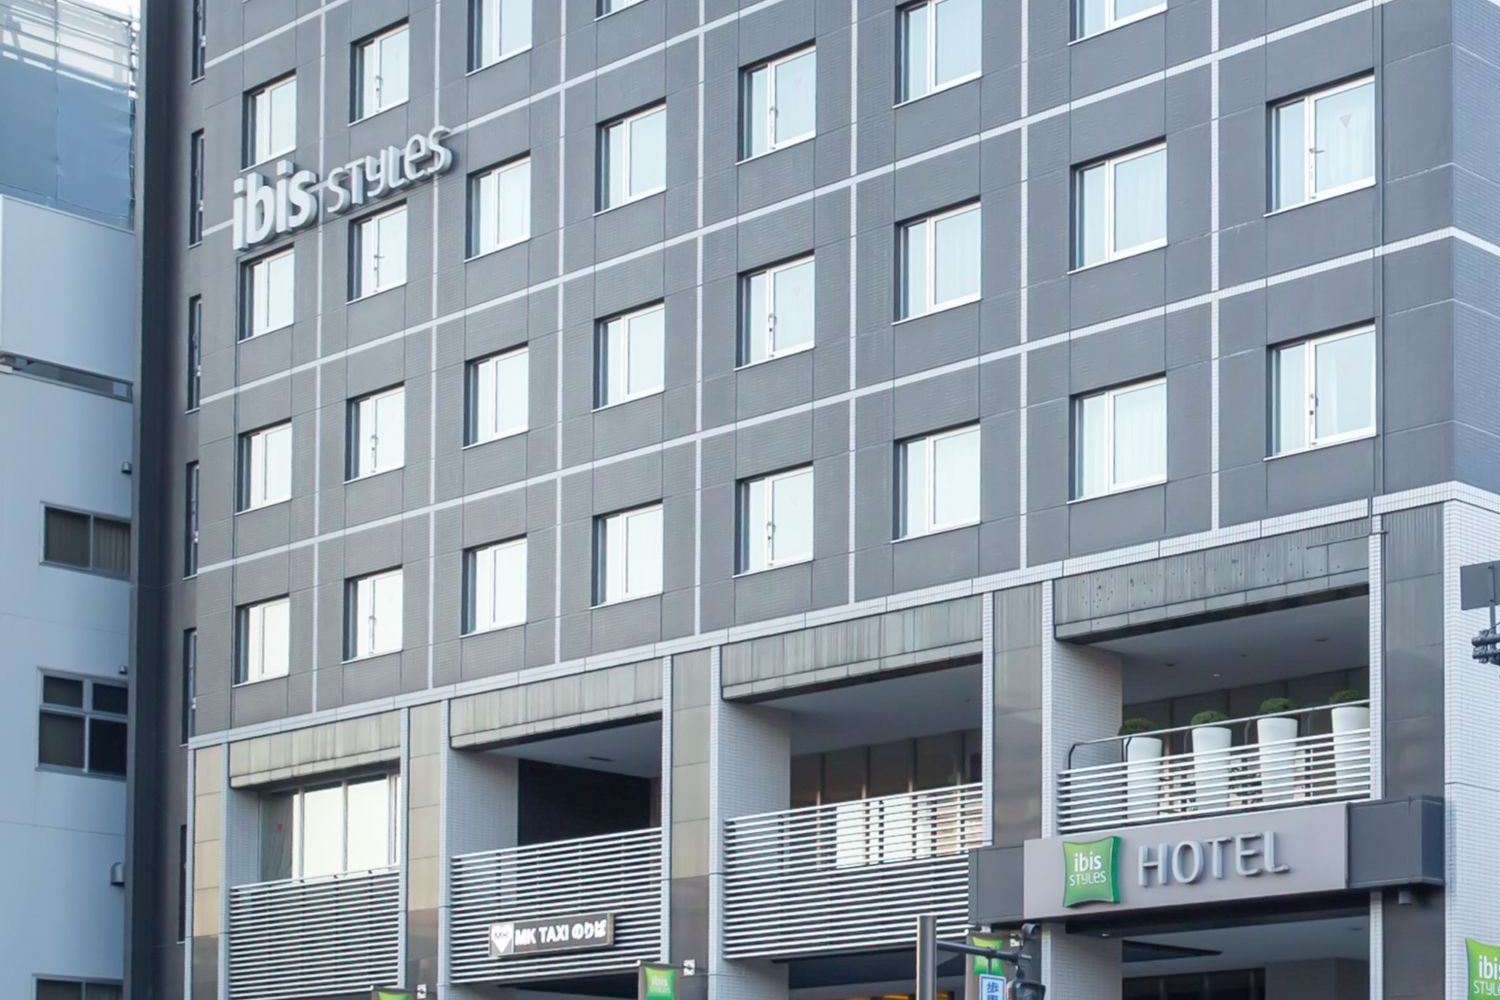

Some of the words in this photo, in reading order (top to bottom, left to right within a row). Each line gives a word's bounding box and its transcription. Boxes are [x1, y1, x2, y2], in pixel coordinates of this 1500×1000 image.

[233, 159, 318, 250] ibis
[1074, 851, 1102, 873] ibis
[1137, 830, 1291, 887] HOTEL
[514, 928, 537, 946] MK
[539, 924, 570, 943] TAXI
[571, 919, 607, 940] のりば
